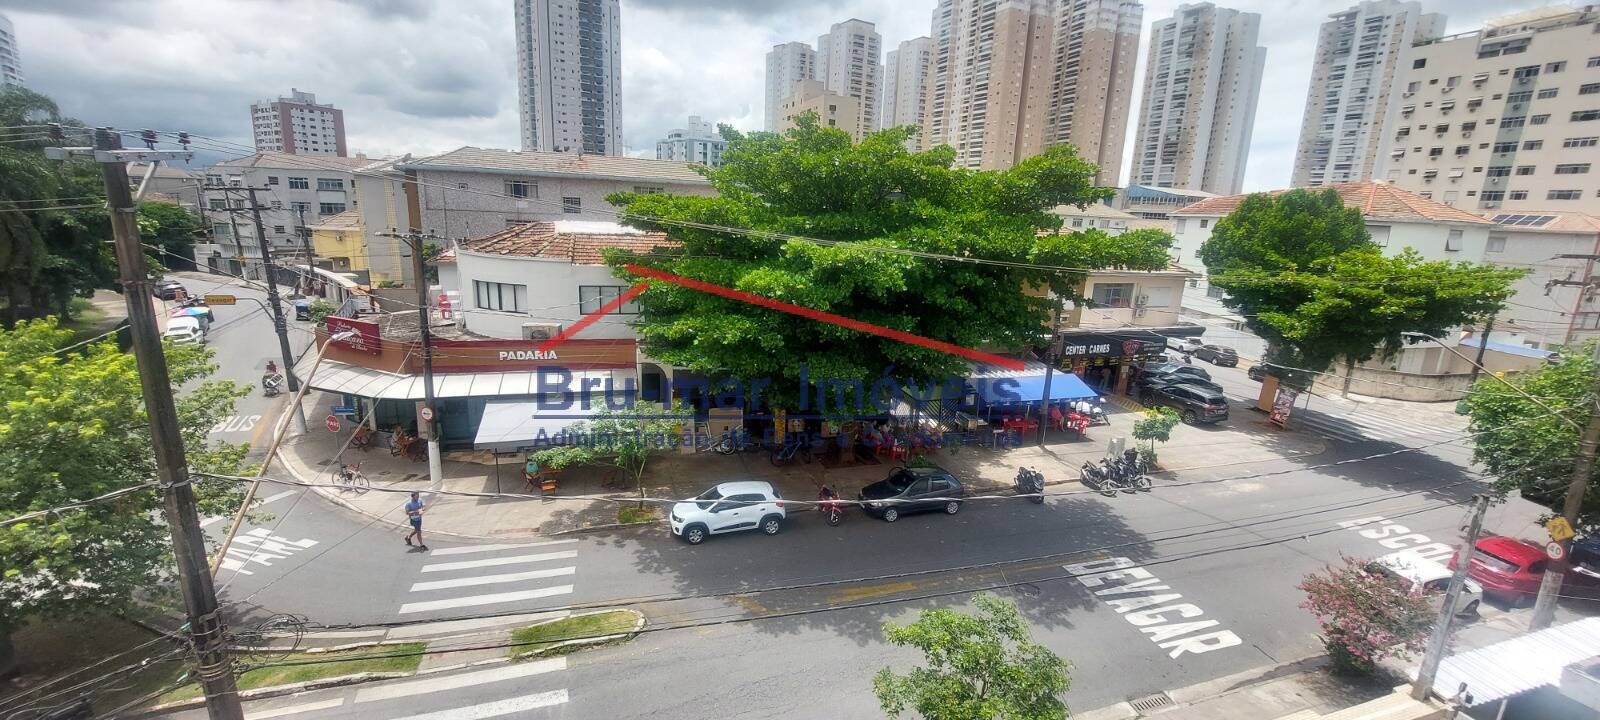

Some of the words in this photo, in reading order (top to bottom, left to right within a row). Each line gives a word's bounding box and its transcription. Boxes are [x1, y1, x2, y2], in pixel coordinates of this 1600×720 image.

[1065, 345, 1087, 355] CENTER
[1089, 343, 1111, 354] CARNES
[499, 350, 558, 360] PADARIA
[1548, 545, 1562, 556] 40
[1062, 556, 1243, 659] DEVAGAR
